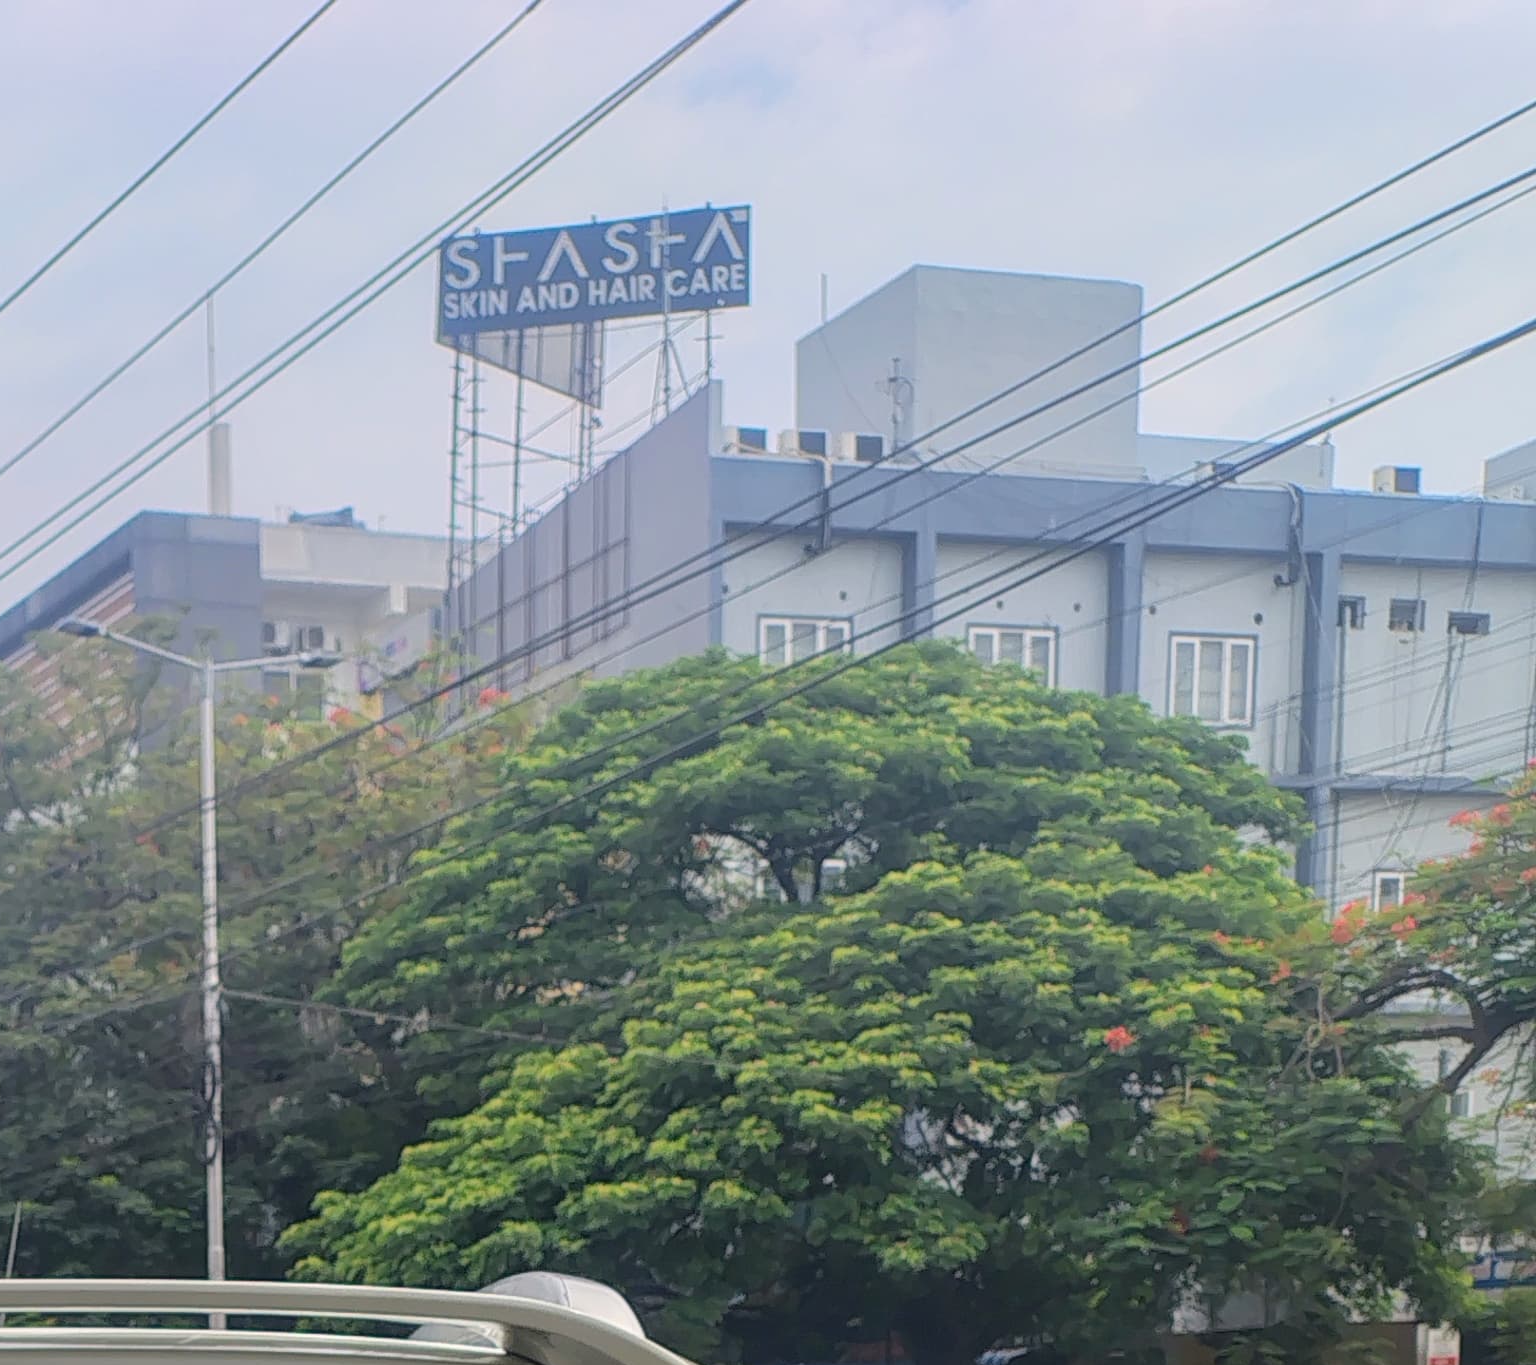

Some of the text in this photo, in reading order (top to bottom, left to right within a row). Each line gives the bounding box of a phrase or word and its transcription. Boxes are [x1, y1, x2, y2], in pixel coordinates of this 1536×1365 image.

[443, 263, 746, 320] SKIN AND HAIR CARE
